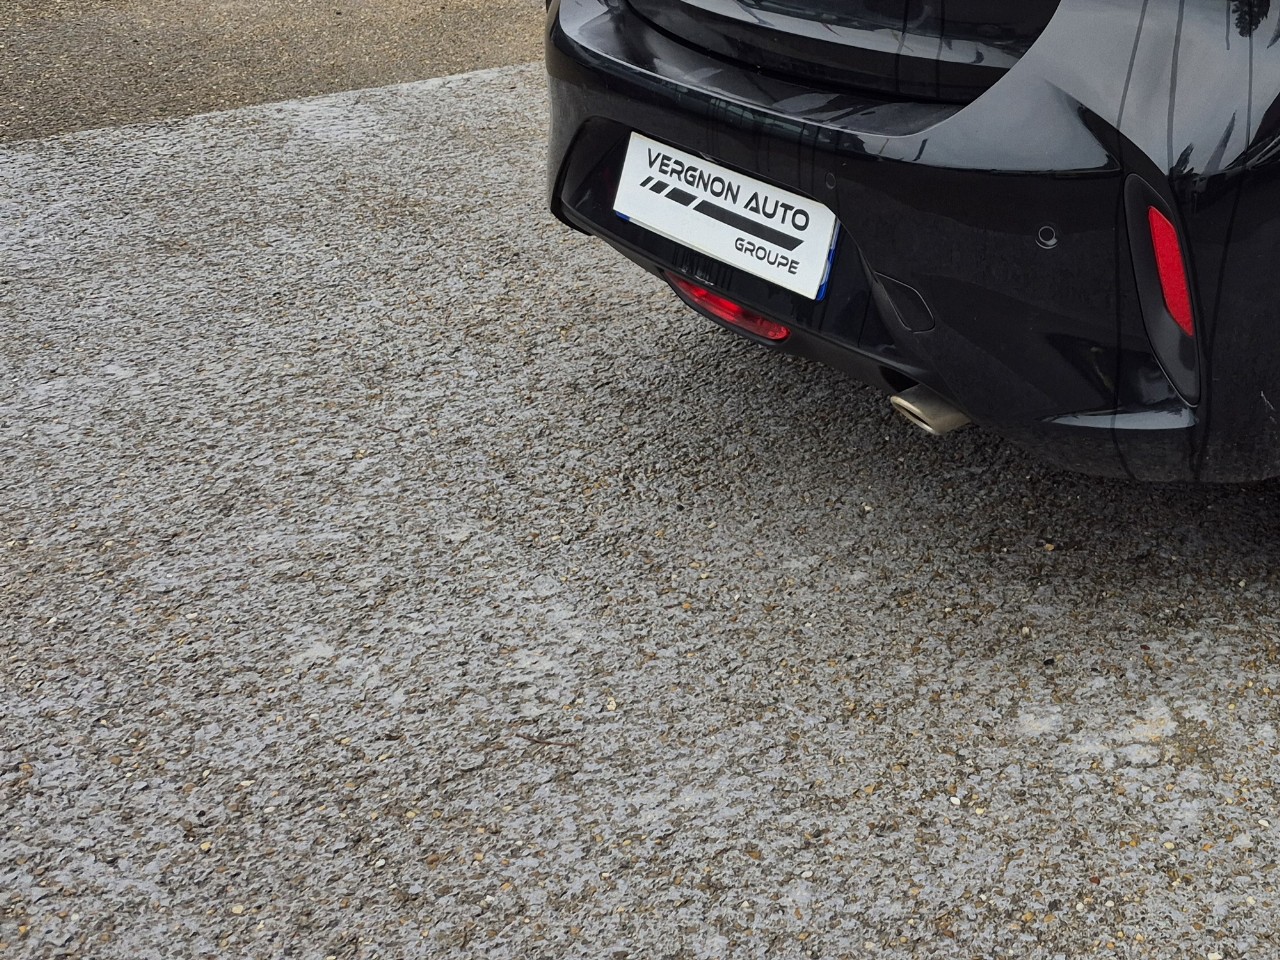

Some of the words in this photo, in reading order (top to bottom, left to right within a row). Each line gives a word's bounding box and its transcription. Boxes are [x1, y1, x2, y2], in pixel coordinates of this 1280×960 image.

[647, 147, 741, 205] VERGNON
[743, 191, 810, 232] AUTO
[734, 236, 801, 276] GROUPE
